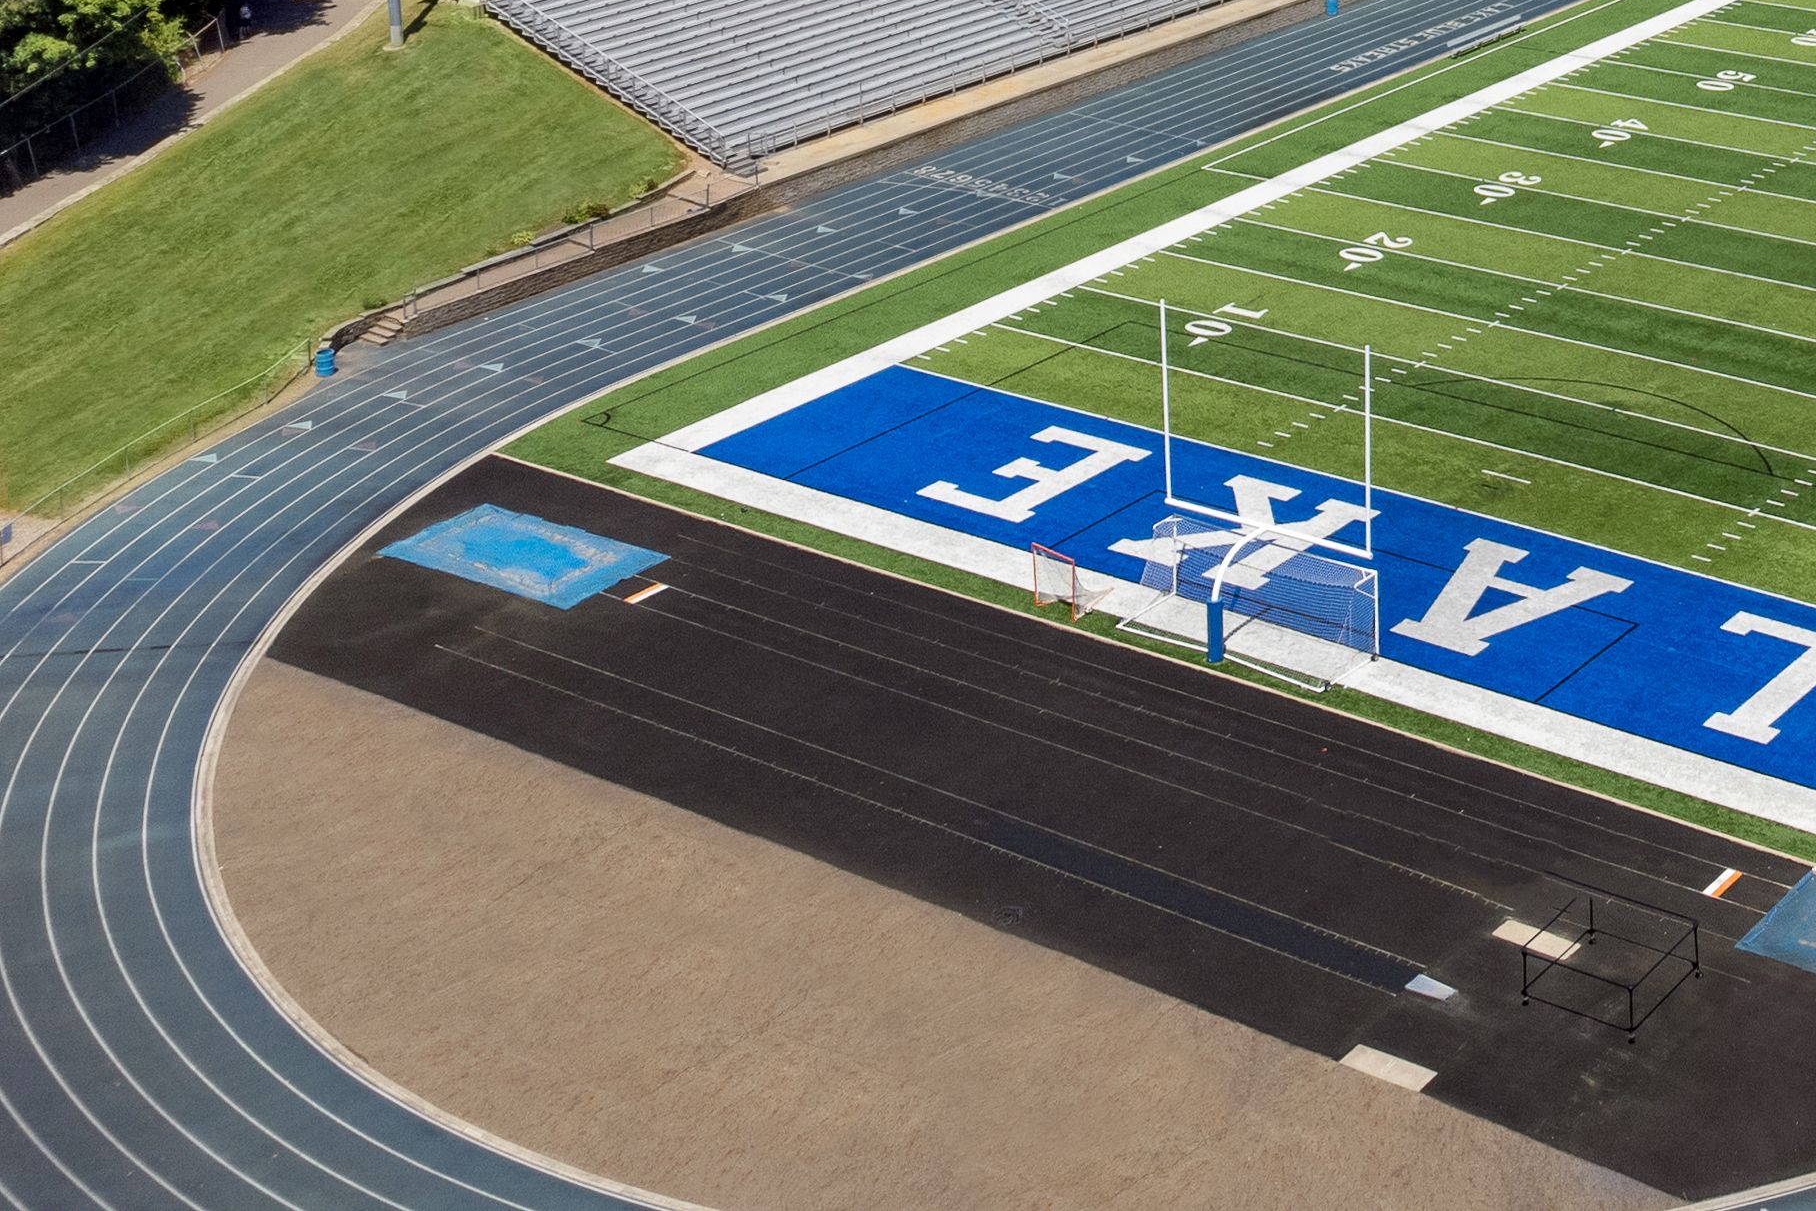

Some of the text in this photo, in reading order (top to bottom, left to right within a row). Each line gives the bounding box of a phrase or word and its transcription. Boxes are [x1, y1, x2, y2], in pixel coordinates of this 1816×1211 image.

[1696, 69, 1756, 91] 50
[1591, 118, 1648, 143] 40
[1473, 171, 1542, 199] 30
[1338, 231, 1413, 263] 20
[1184, 302, 1269, 337] 10
